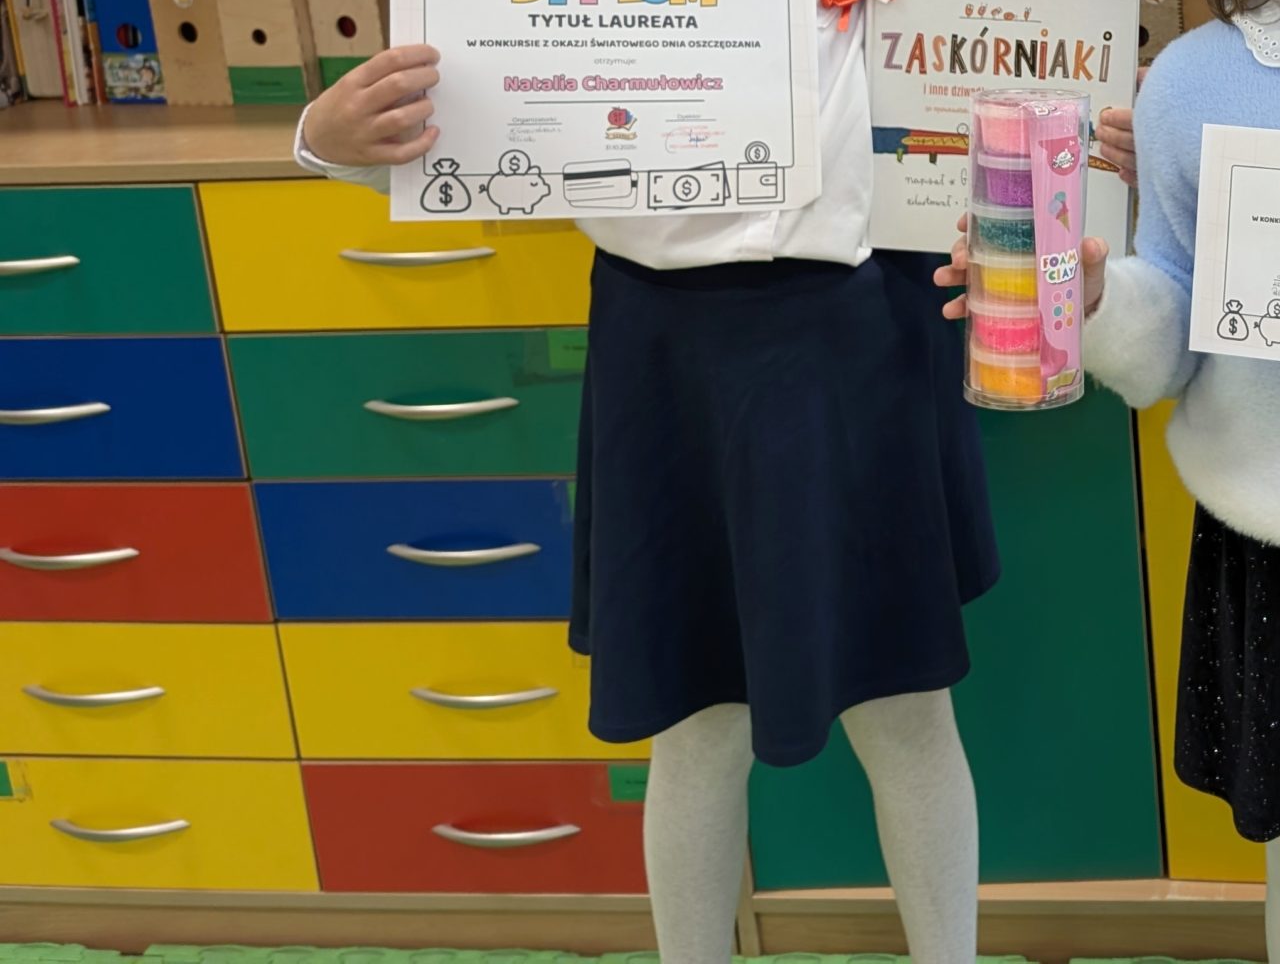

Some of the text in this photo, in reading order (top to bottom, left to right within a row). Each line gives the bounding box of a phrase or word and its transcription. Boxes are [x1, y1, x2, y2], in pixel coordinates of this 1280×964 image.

[528, 13, 698, 29] TYTUŁ LAUREATA
[466, 37, 761, 50] W KONKURSIE Z OKAZJI ŚWIATOWEGO DNIA OSZCZĘDZANIA
[880, 26, 1113, 84] ZASKÓRNIAKI
[504, 72, 724, 92] Natalia Charmułowicz
[1041, 250, 1078, 271] FOAM
